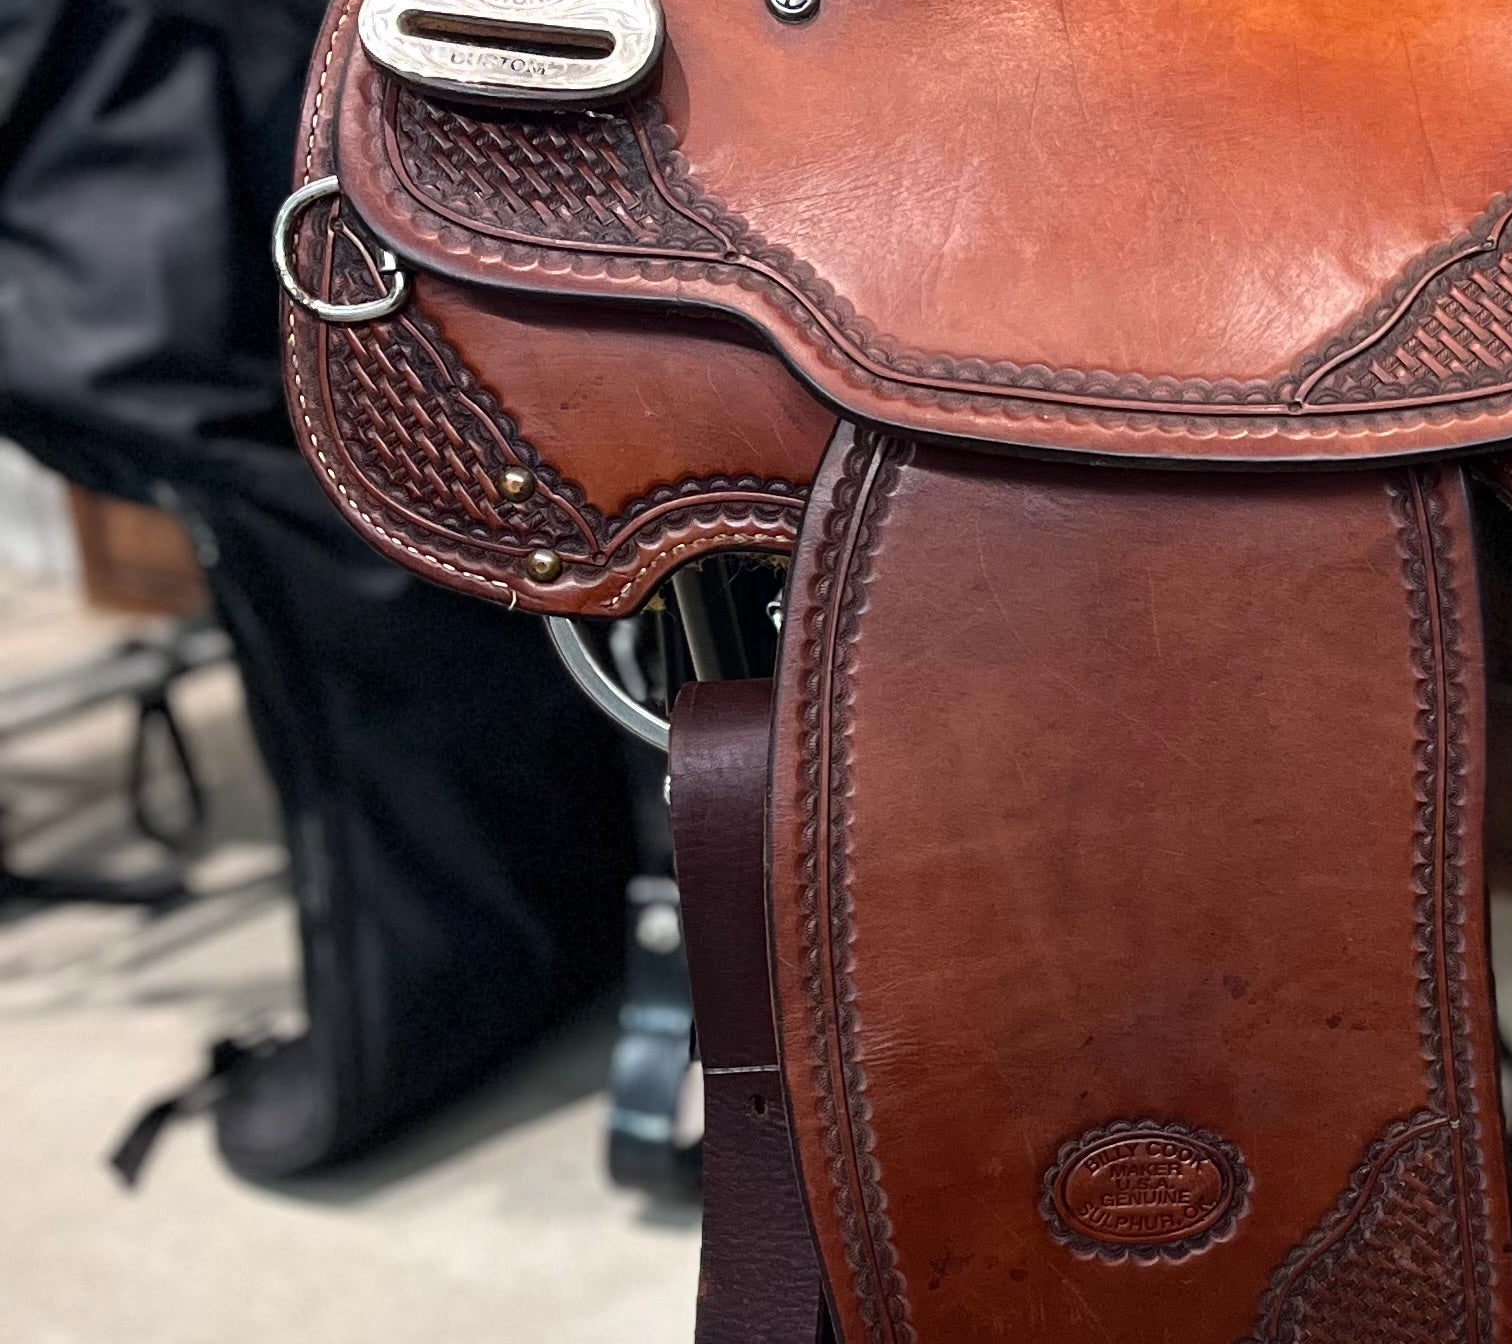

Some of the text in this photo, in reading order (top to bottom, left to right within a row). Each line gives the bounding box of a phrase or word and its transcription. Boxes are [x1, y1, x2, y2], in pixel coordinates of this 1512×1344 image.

[1084, 1142, 1211, 1175] BILLY COOK
[1102, 1190, 1192, 1207] GENUINE
